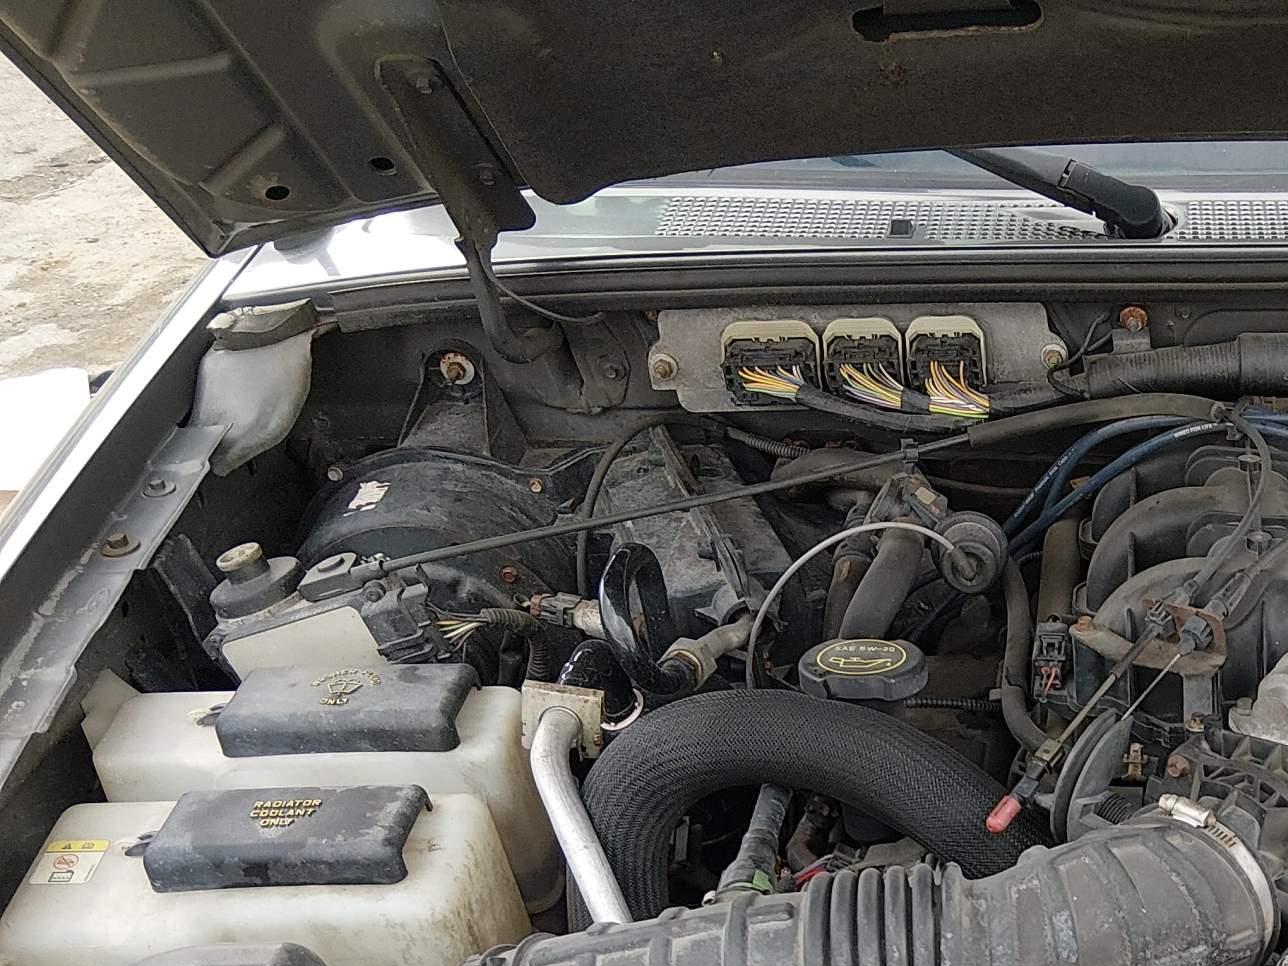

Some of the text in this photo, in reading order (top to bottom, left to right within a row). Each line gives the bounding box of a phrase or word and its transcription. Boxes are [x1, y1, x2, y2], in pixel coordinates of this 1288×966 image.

[319, 696, 350, 706] ONLY
[253, 799, 322, 809] RADIATOR
[250, 808, 316, 819] COOLANT
[259, 817, 295, 827] ONLY
